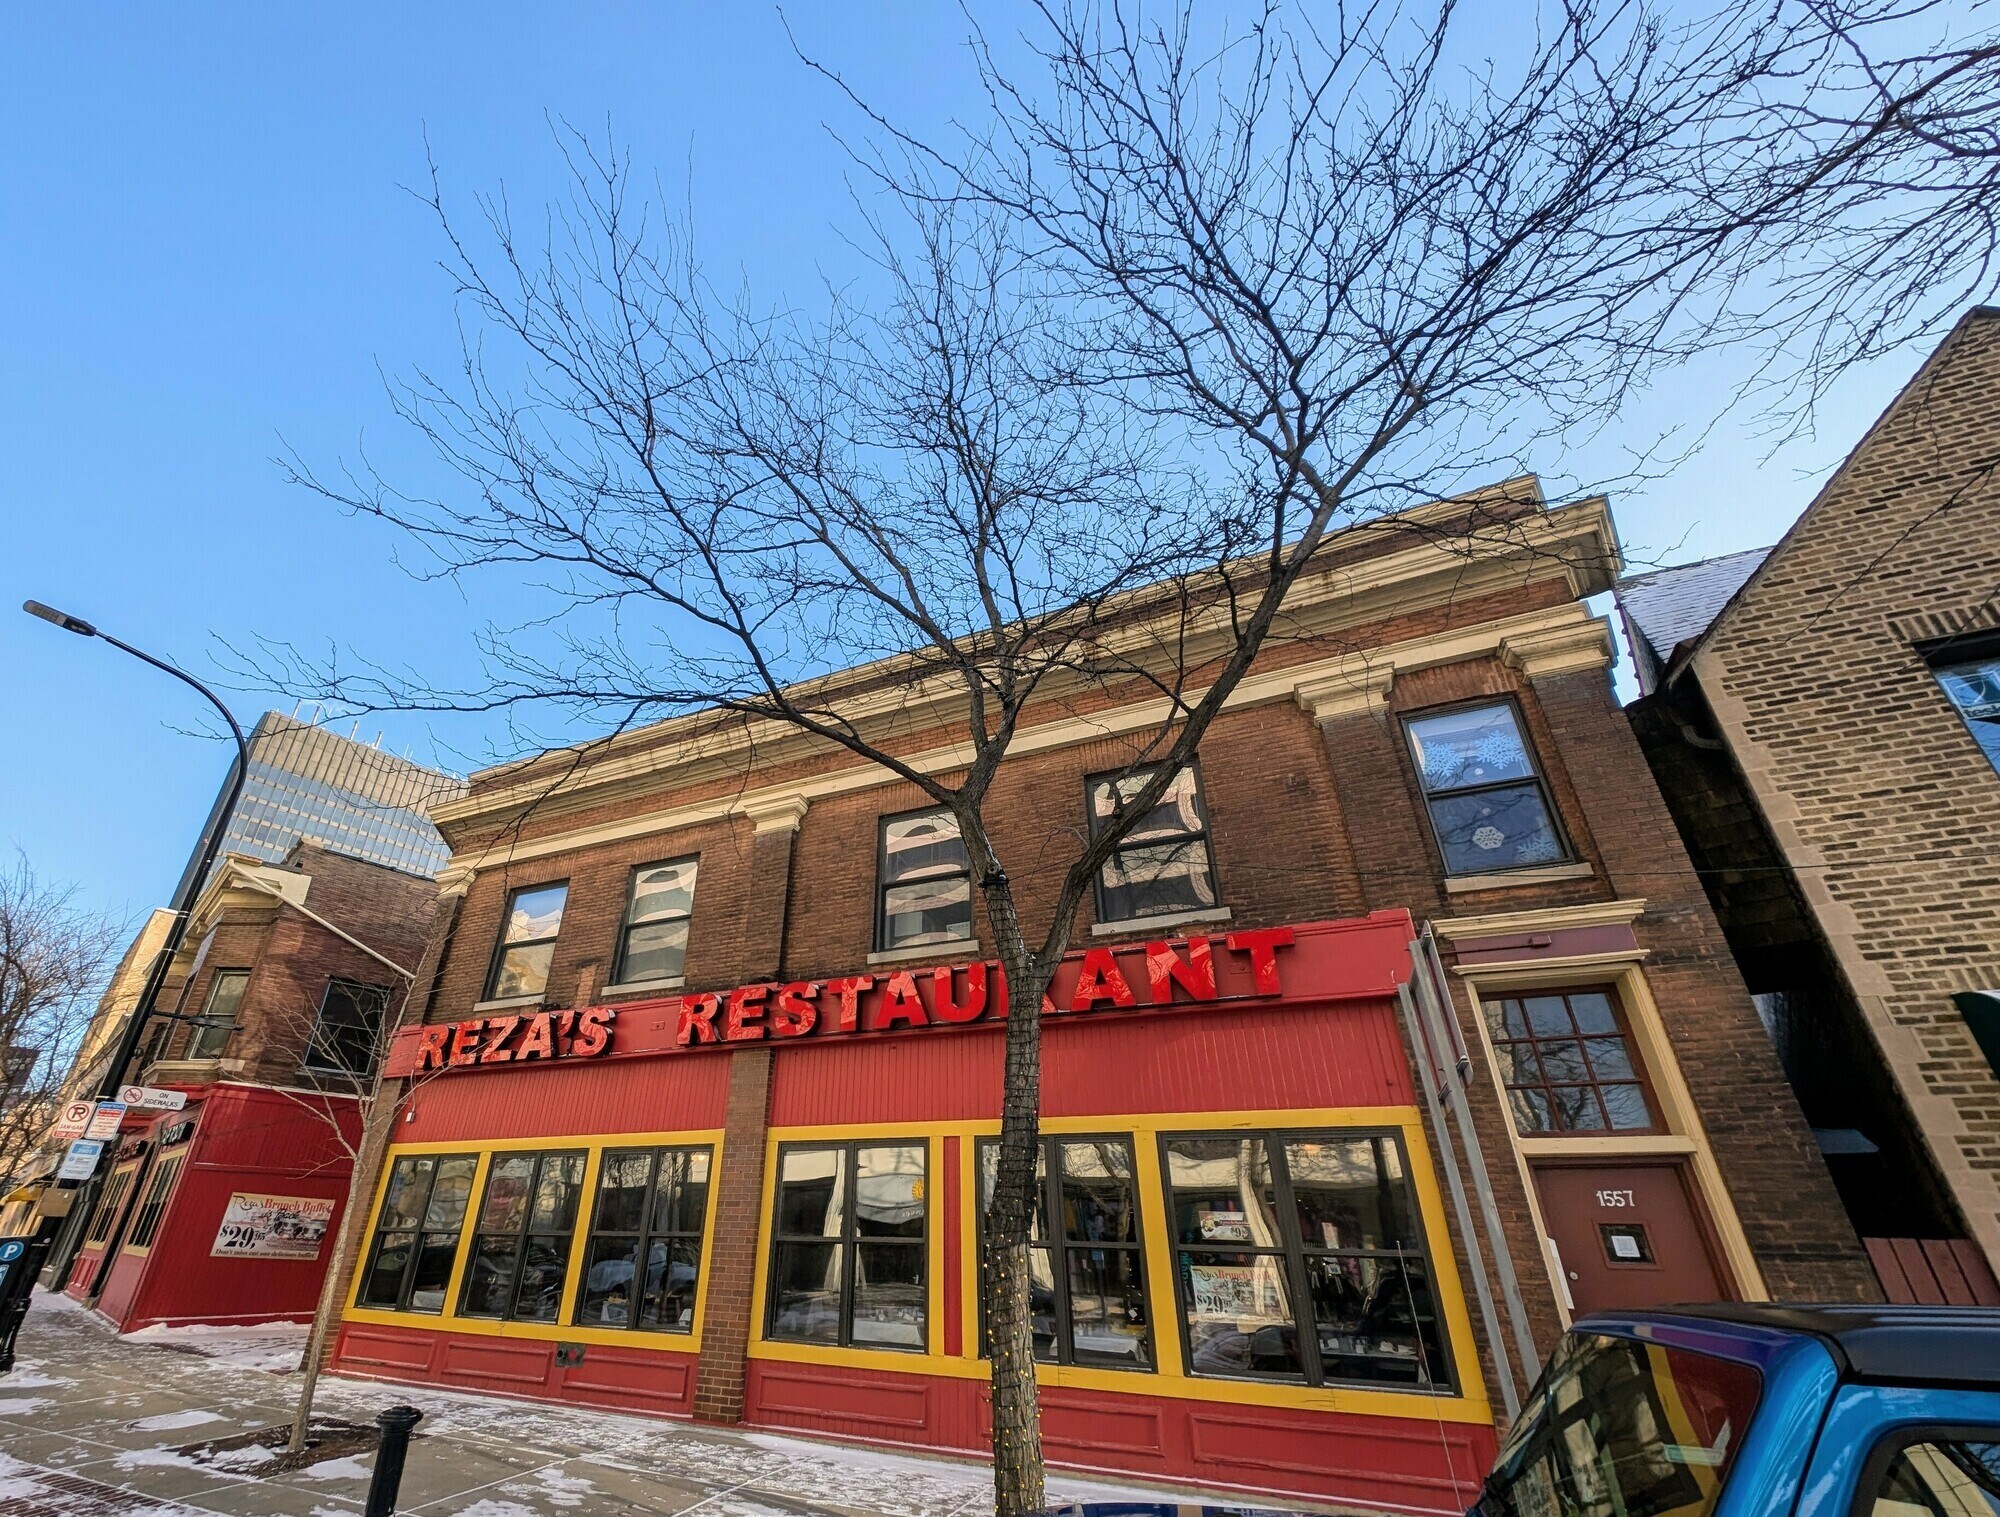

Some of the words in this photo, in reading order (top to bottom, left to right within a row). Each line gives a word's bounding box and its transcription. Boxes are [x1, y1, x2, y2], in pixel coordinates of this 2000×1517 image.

[413, 1007, 611, 1069] REZA'S
[143, 1098, 179, 1108] SIDEWALKS
[264, 1198, 300, 1211] Brunch
[303, 1201, 332, 1215] Buffet
[1596, 1190, 1635, 1207] 1557
